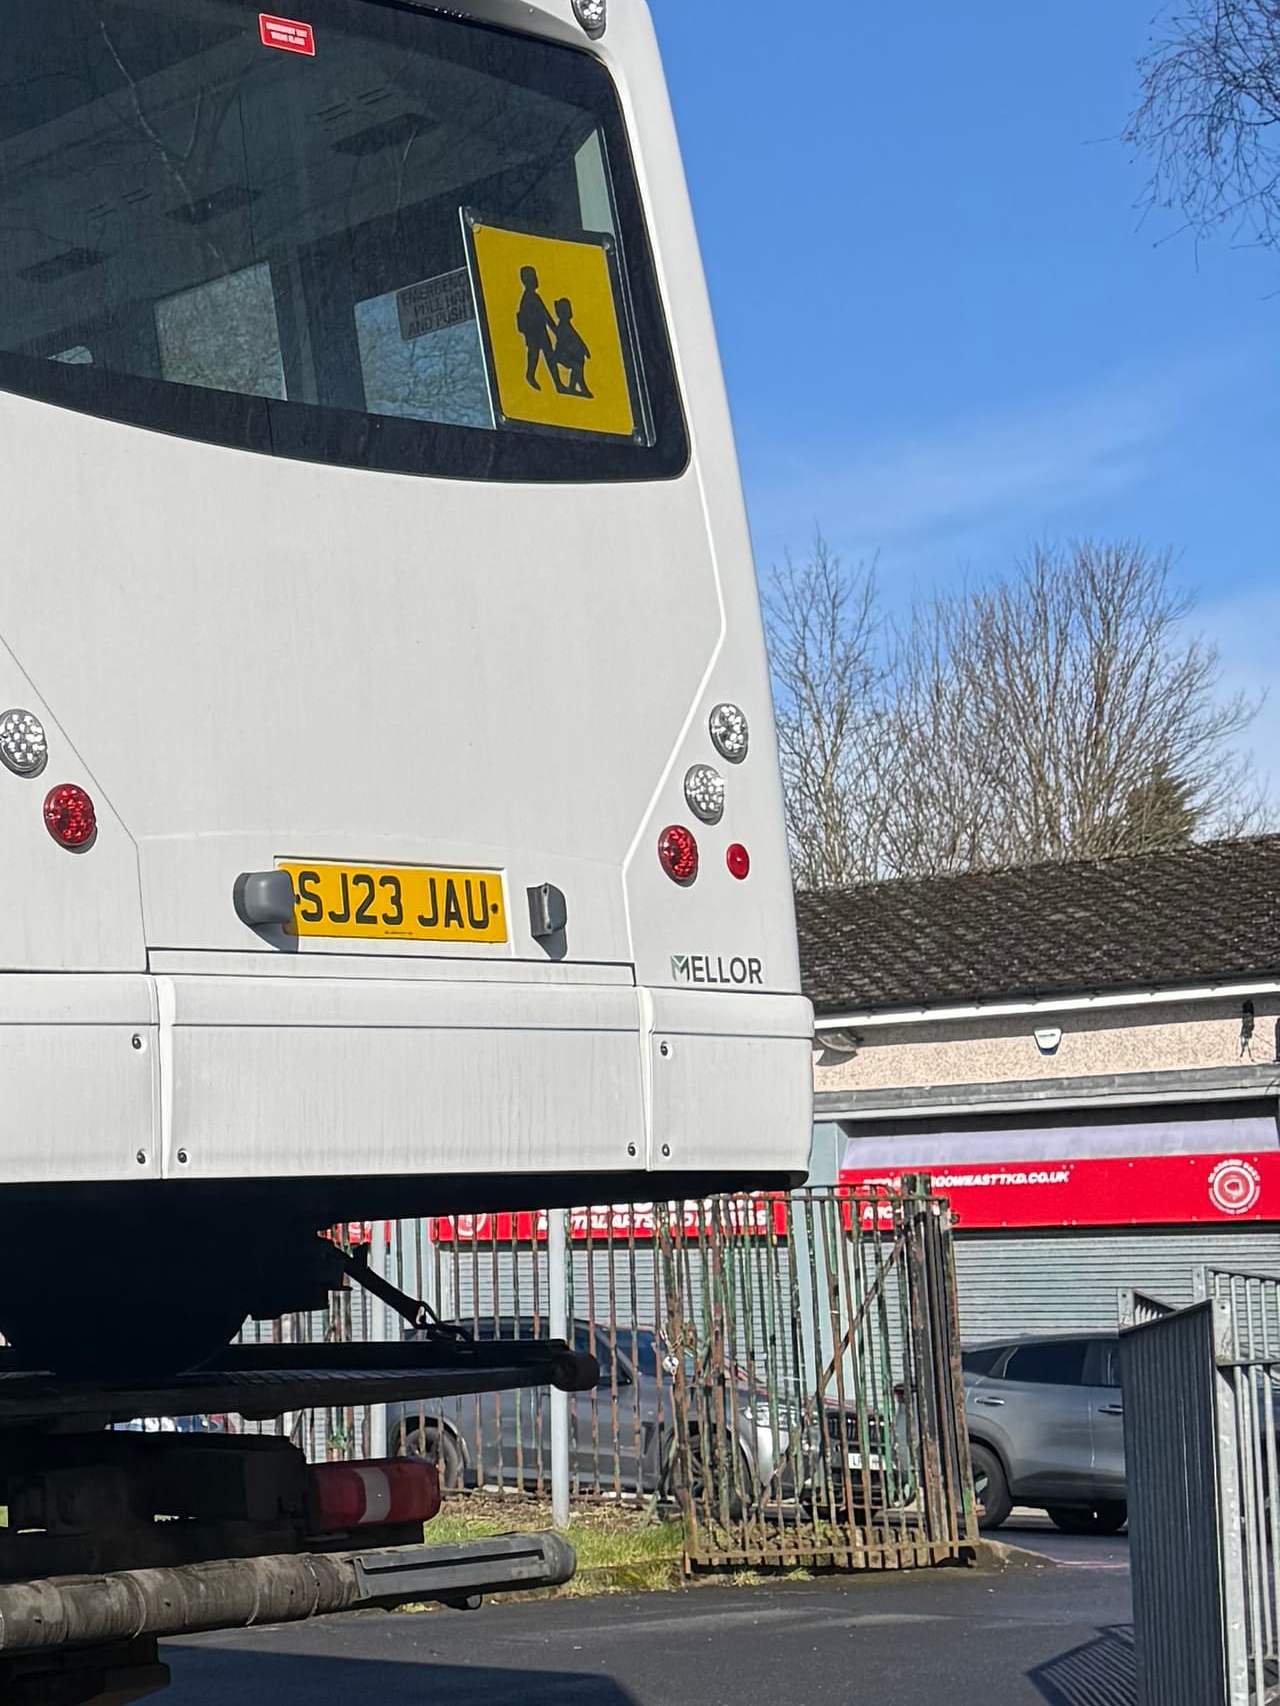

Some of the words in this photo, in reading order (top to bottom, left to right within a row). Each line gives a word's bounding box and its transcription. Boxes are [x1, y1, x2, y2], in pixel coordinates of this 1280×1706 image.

[401, 273, 466, 306] EMERGENC
[446, 289, 470, 308] HAN
[409, 317, 433, 336] AND
[437, 304, 468, 326] PUSH
[298, 871, 404, 925] SJ23
[418, 877, 490, 929] JAU
[671, 955, 763, 984] MELLOR
